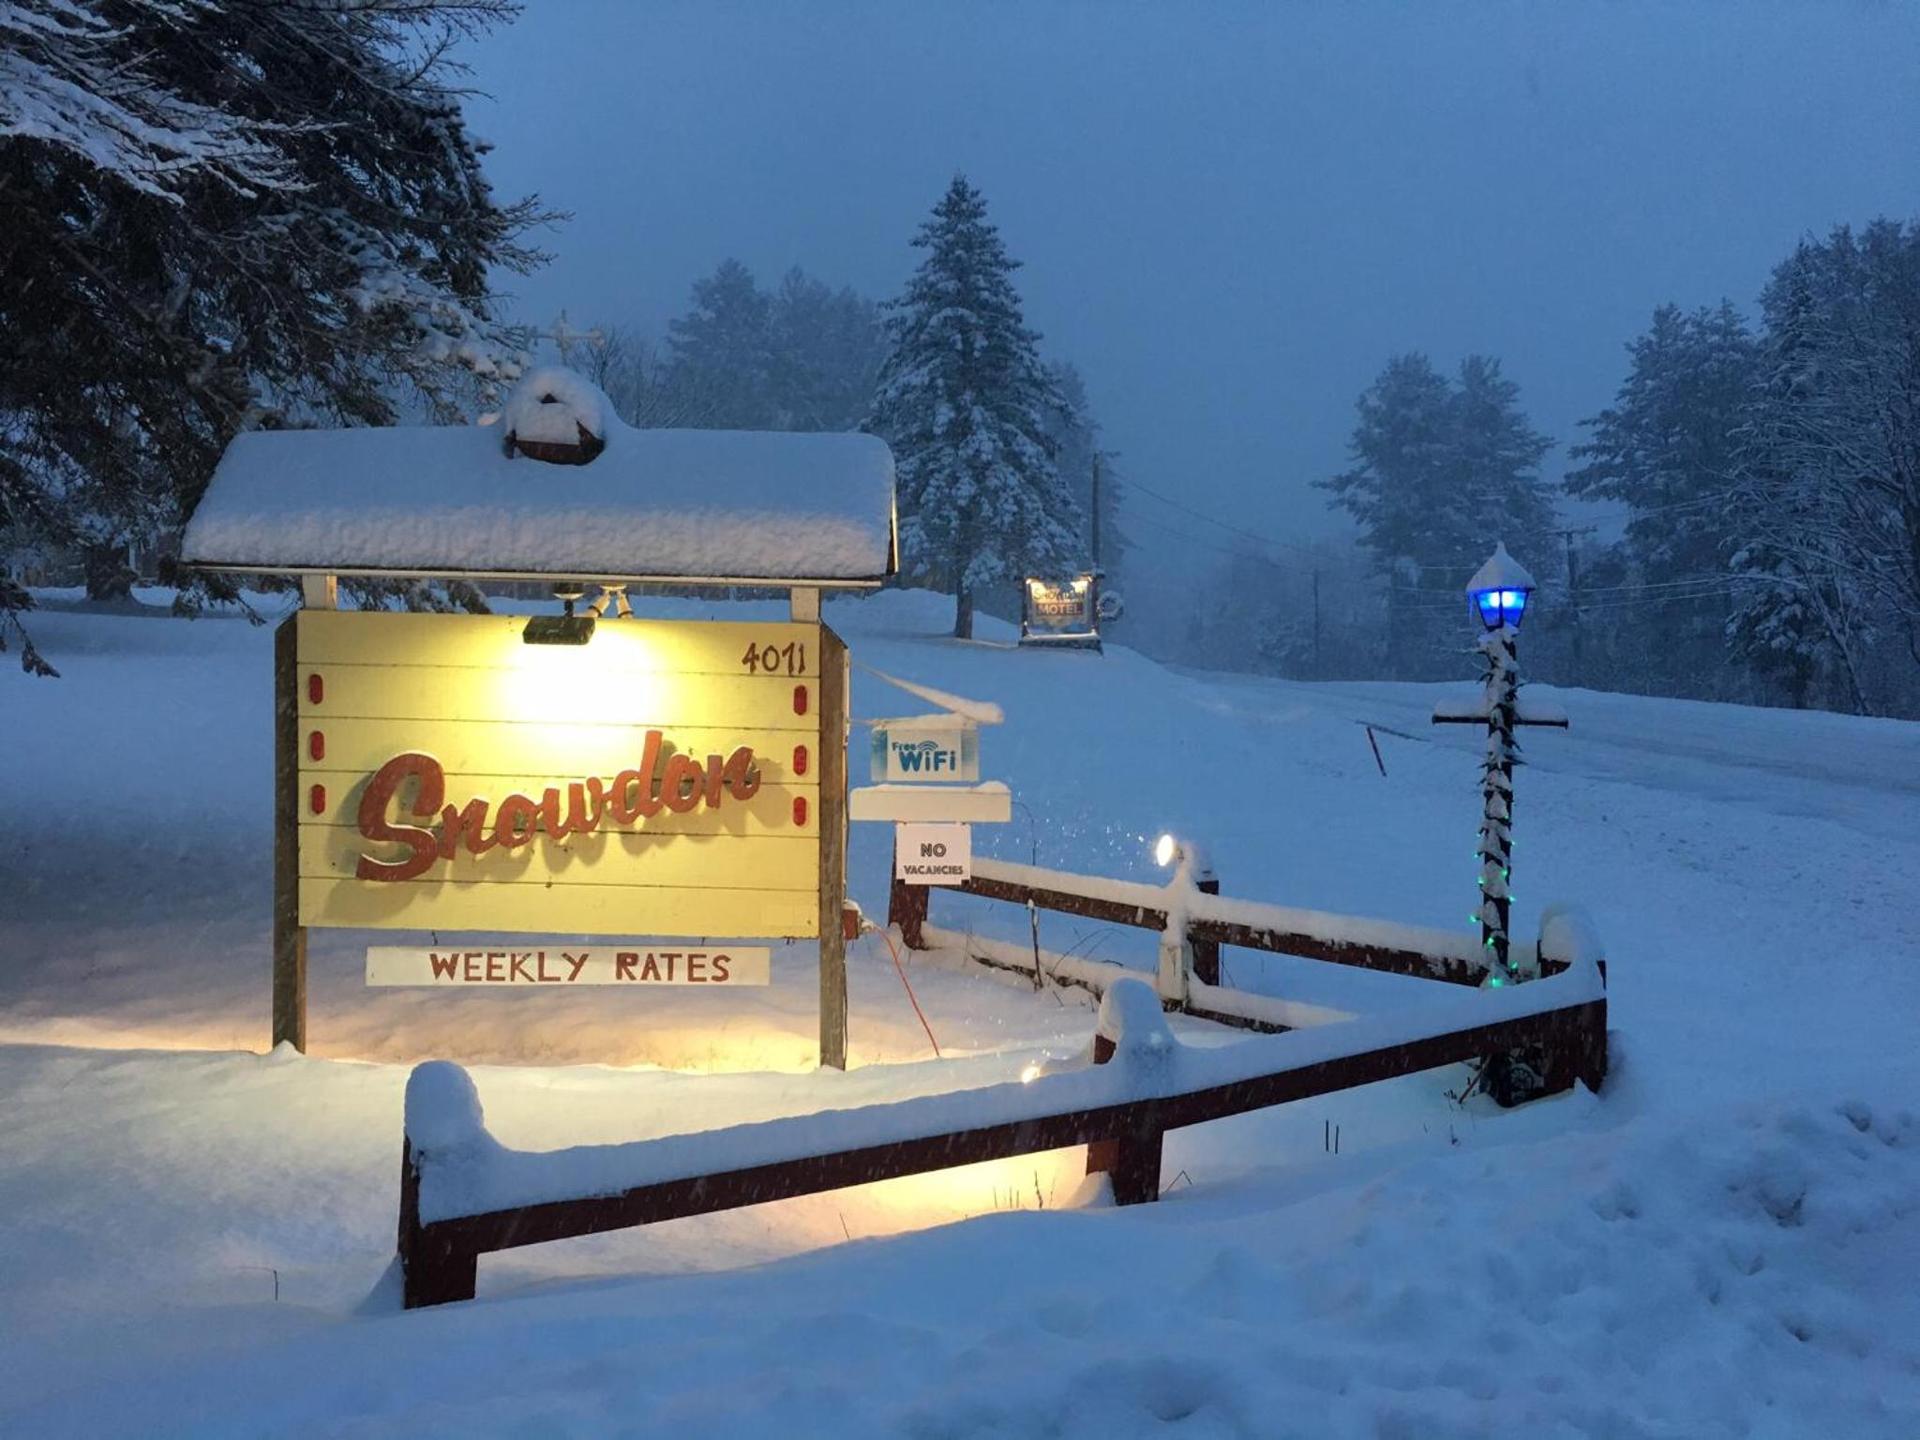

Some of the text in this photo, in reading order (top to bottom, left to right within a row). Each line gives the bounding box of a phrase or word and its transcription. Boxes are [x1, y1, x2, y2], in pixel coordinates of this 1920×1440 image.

[1038, 604, 1081, 615] MOTEL
[892, 742, 916, 751] Free
[899, 751, 956, 772] WiFi
[355, 731, 761, 882] Snowdon
[920, 843, 947, 858] NO
[903, 865, 964, 875] VACANCIES
[429, 952, 731, 982] WEEKLY RATES
